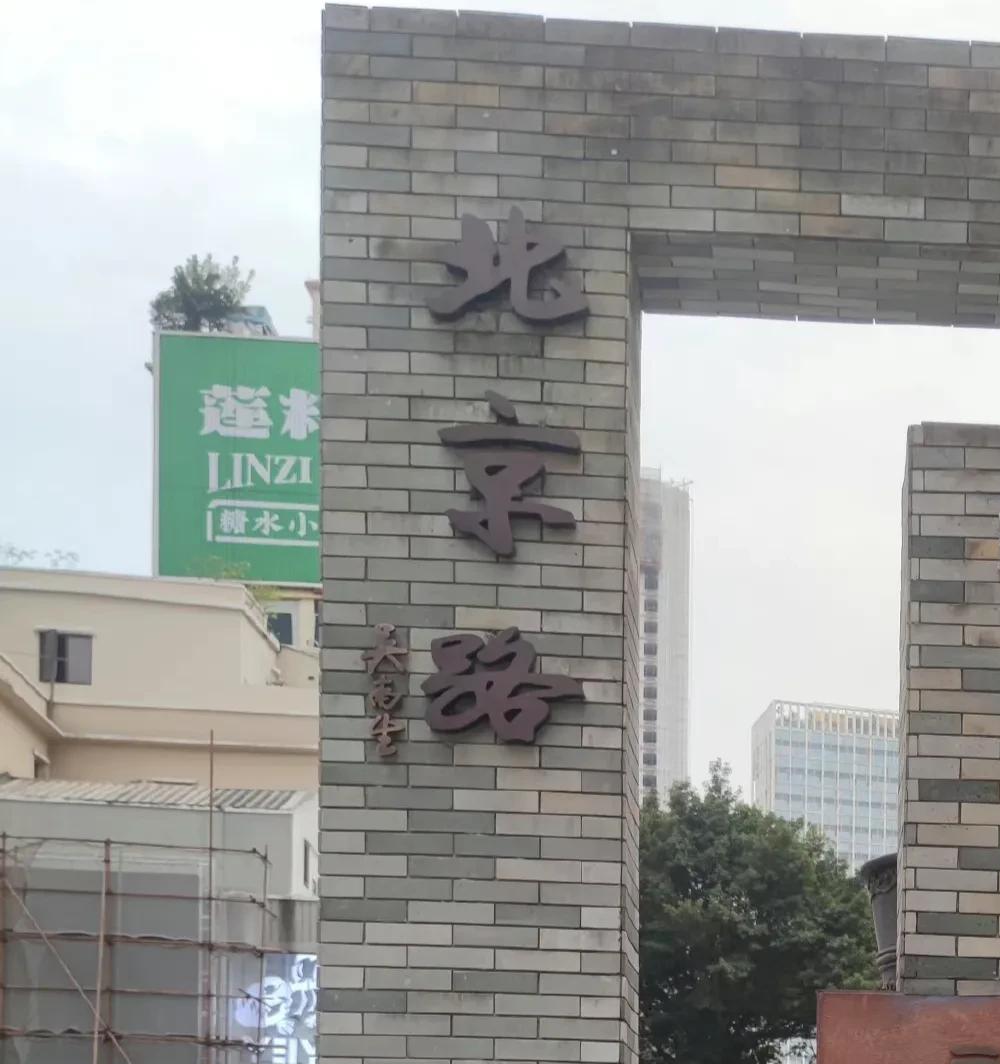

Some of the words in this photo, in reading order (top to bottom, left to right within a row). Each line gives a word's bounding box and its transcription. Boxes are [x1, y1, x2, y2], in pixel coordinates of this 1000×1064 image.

[207, 452, 313, 494] LINZI
[421, 206, 590, 745] 北京路
